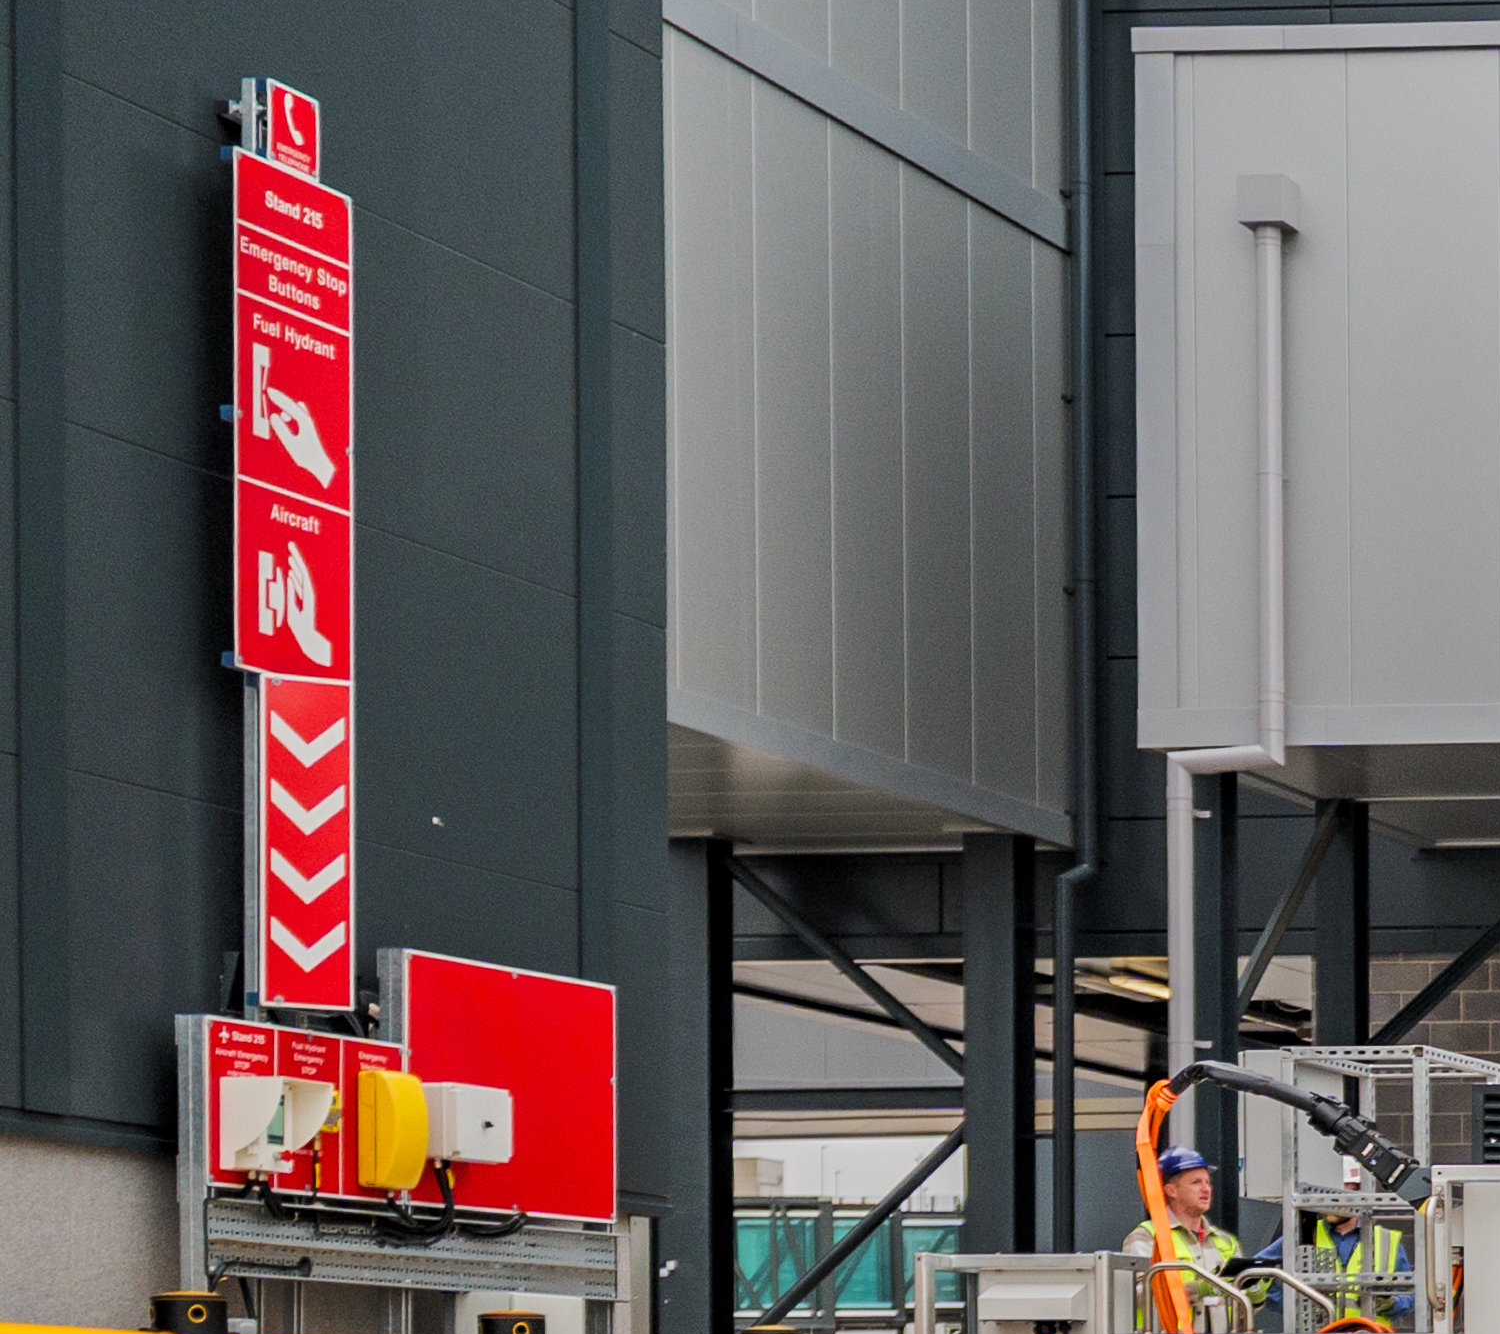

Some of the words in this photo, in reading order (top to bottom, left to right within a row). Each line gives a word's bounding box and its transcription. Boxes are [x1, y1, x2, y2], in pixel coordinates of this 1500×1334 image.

[264, 190, 300, 220] Stand
[302, 207, 324, 230] 215
[240, 235, 313, 283] Emergency
[317, 268, 347, 298] Stop
[268, 274, 320, 310] Buttons
[253, 313, 281, 339] Fuel
[284, 325, 336, 360] Hydrant
[270, 503, 320, 535] Aircraft
[231, 1030, 252, 1044] Stand
[237, 1049, 269, 1064] Emergency
[293, 1052, 325, 1066] Emergency
[357, 1050, 388, 1064] Emergency
